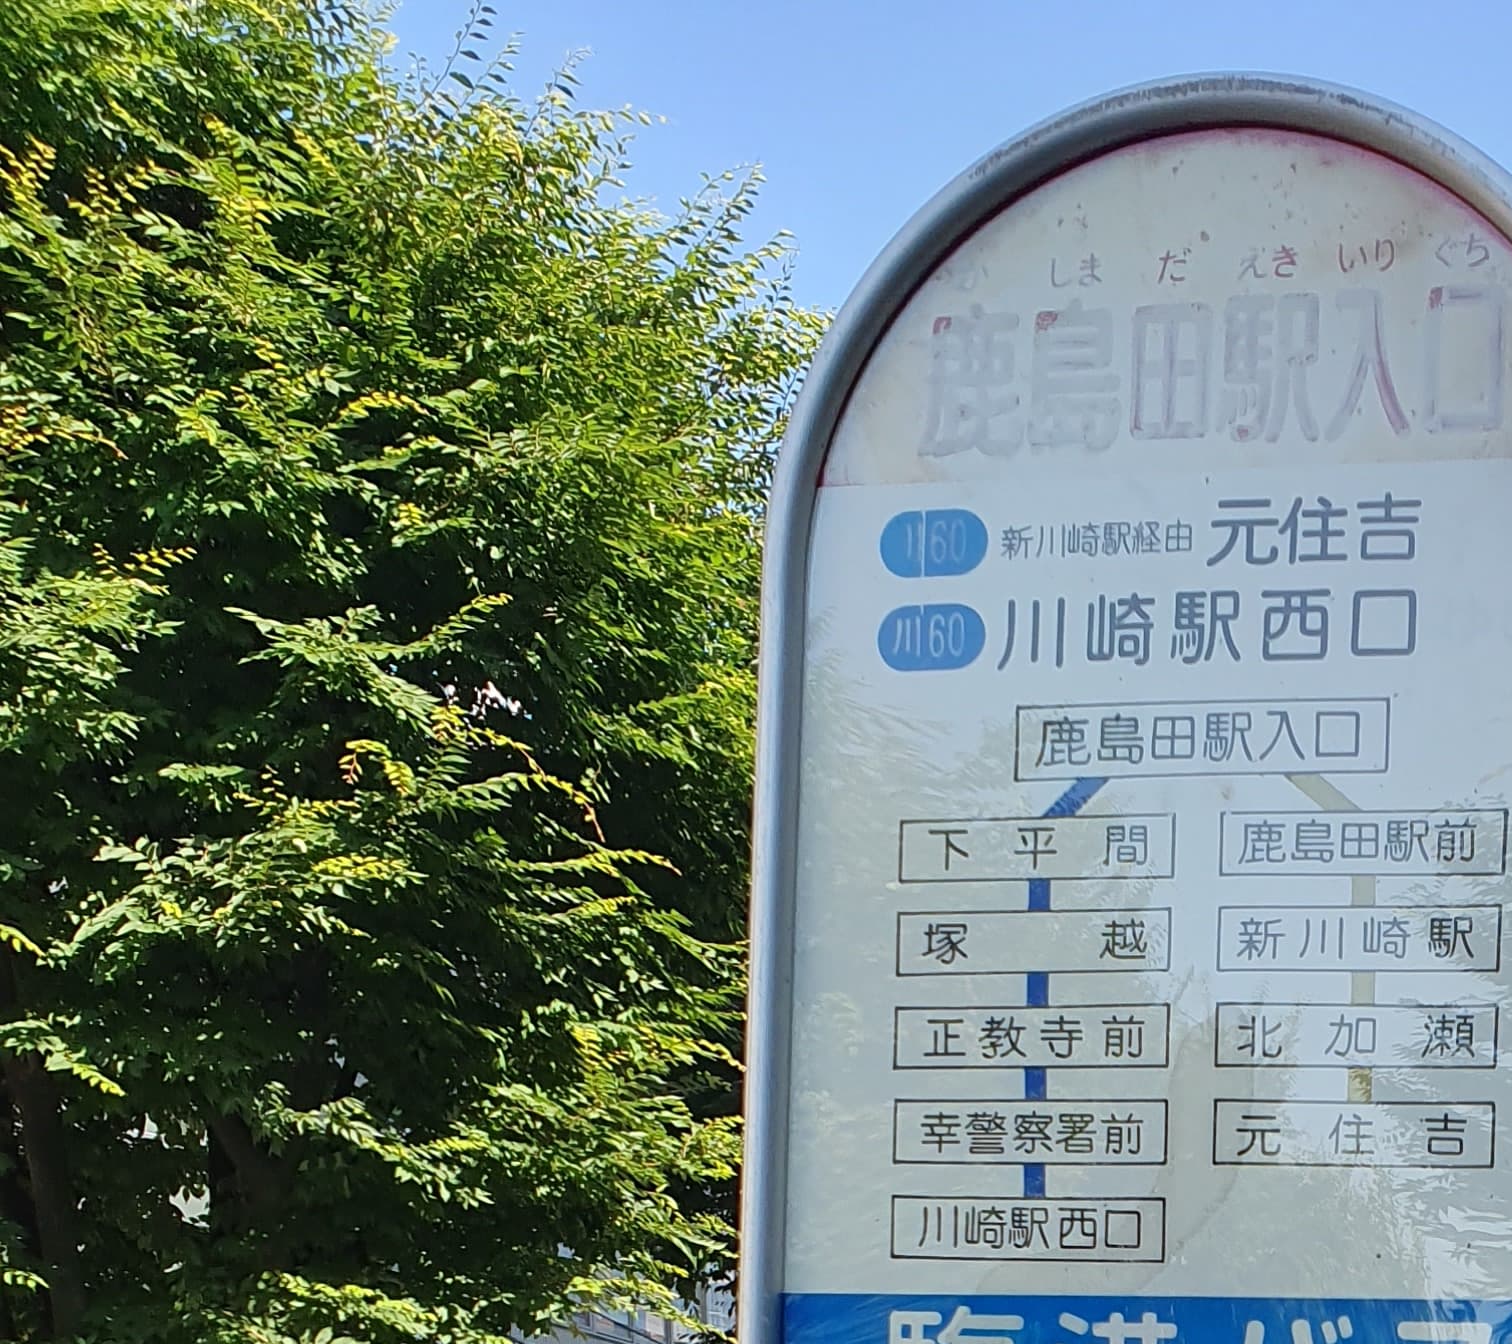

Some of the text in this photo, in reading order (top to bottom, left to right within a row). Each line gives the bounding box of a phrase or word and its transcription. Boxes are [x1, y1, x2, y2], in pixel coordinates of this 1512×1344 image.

[917, 284, 1508, 458] 鹿島田駅入口
[1000, 518, 1193, 561] 新川崎駅経由
[1206, 493, 1422, 567] 元住吉
[997, 588, 1418, 672] 川崎駅西口
[1034, 710, 1361, 768] 鹿島田駅入口
[926, 825, 1149, 873] 下平間
[1237, 818, 1477, 866] 鹿島田駅前
[924, 919, 1147, 964] 塚越
[1237, 915, 1475, 962] 新川崎駅
[924, 1015, 1145, 1060] 正教寺前
[1237, 1014, 1476, 1059] 北加瀬
[921, 1112, 1145, 1157] 幸警察署前
[1236, 1114, 1469, 1158] 元住吉
[917, 1209, 1143, 1251] 川崎駅西口
